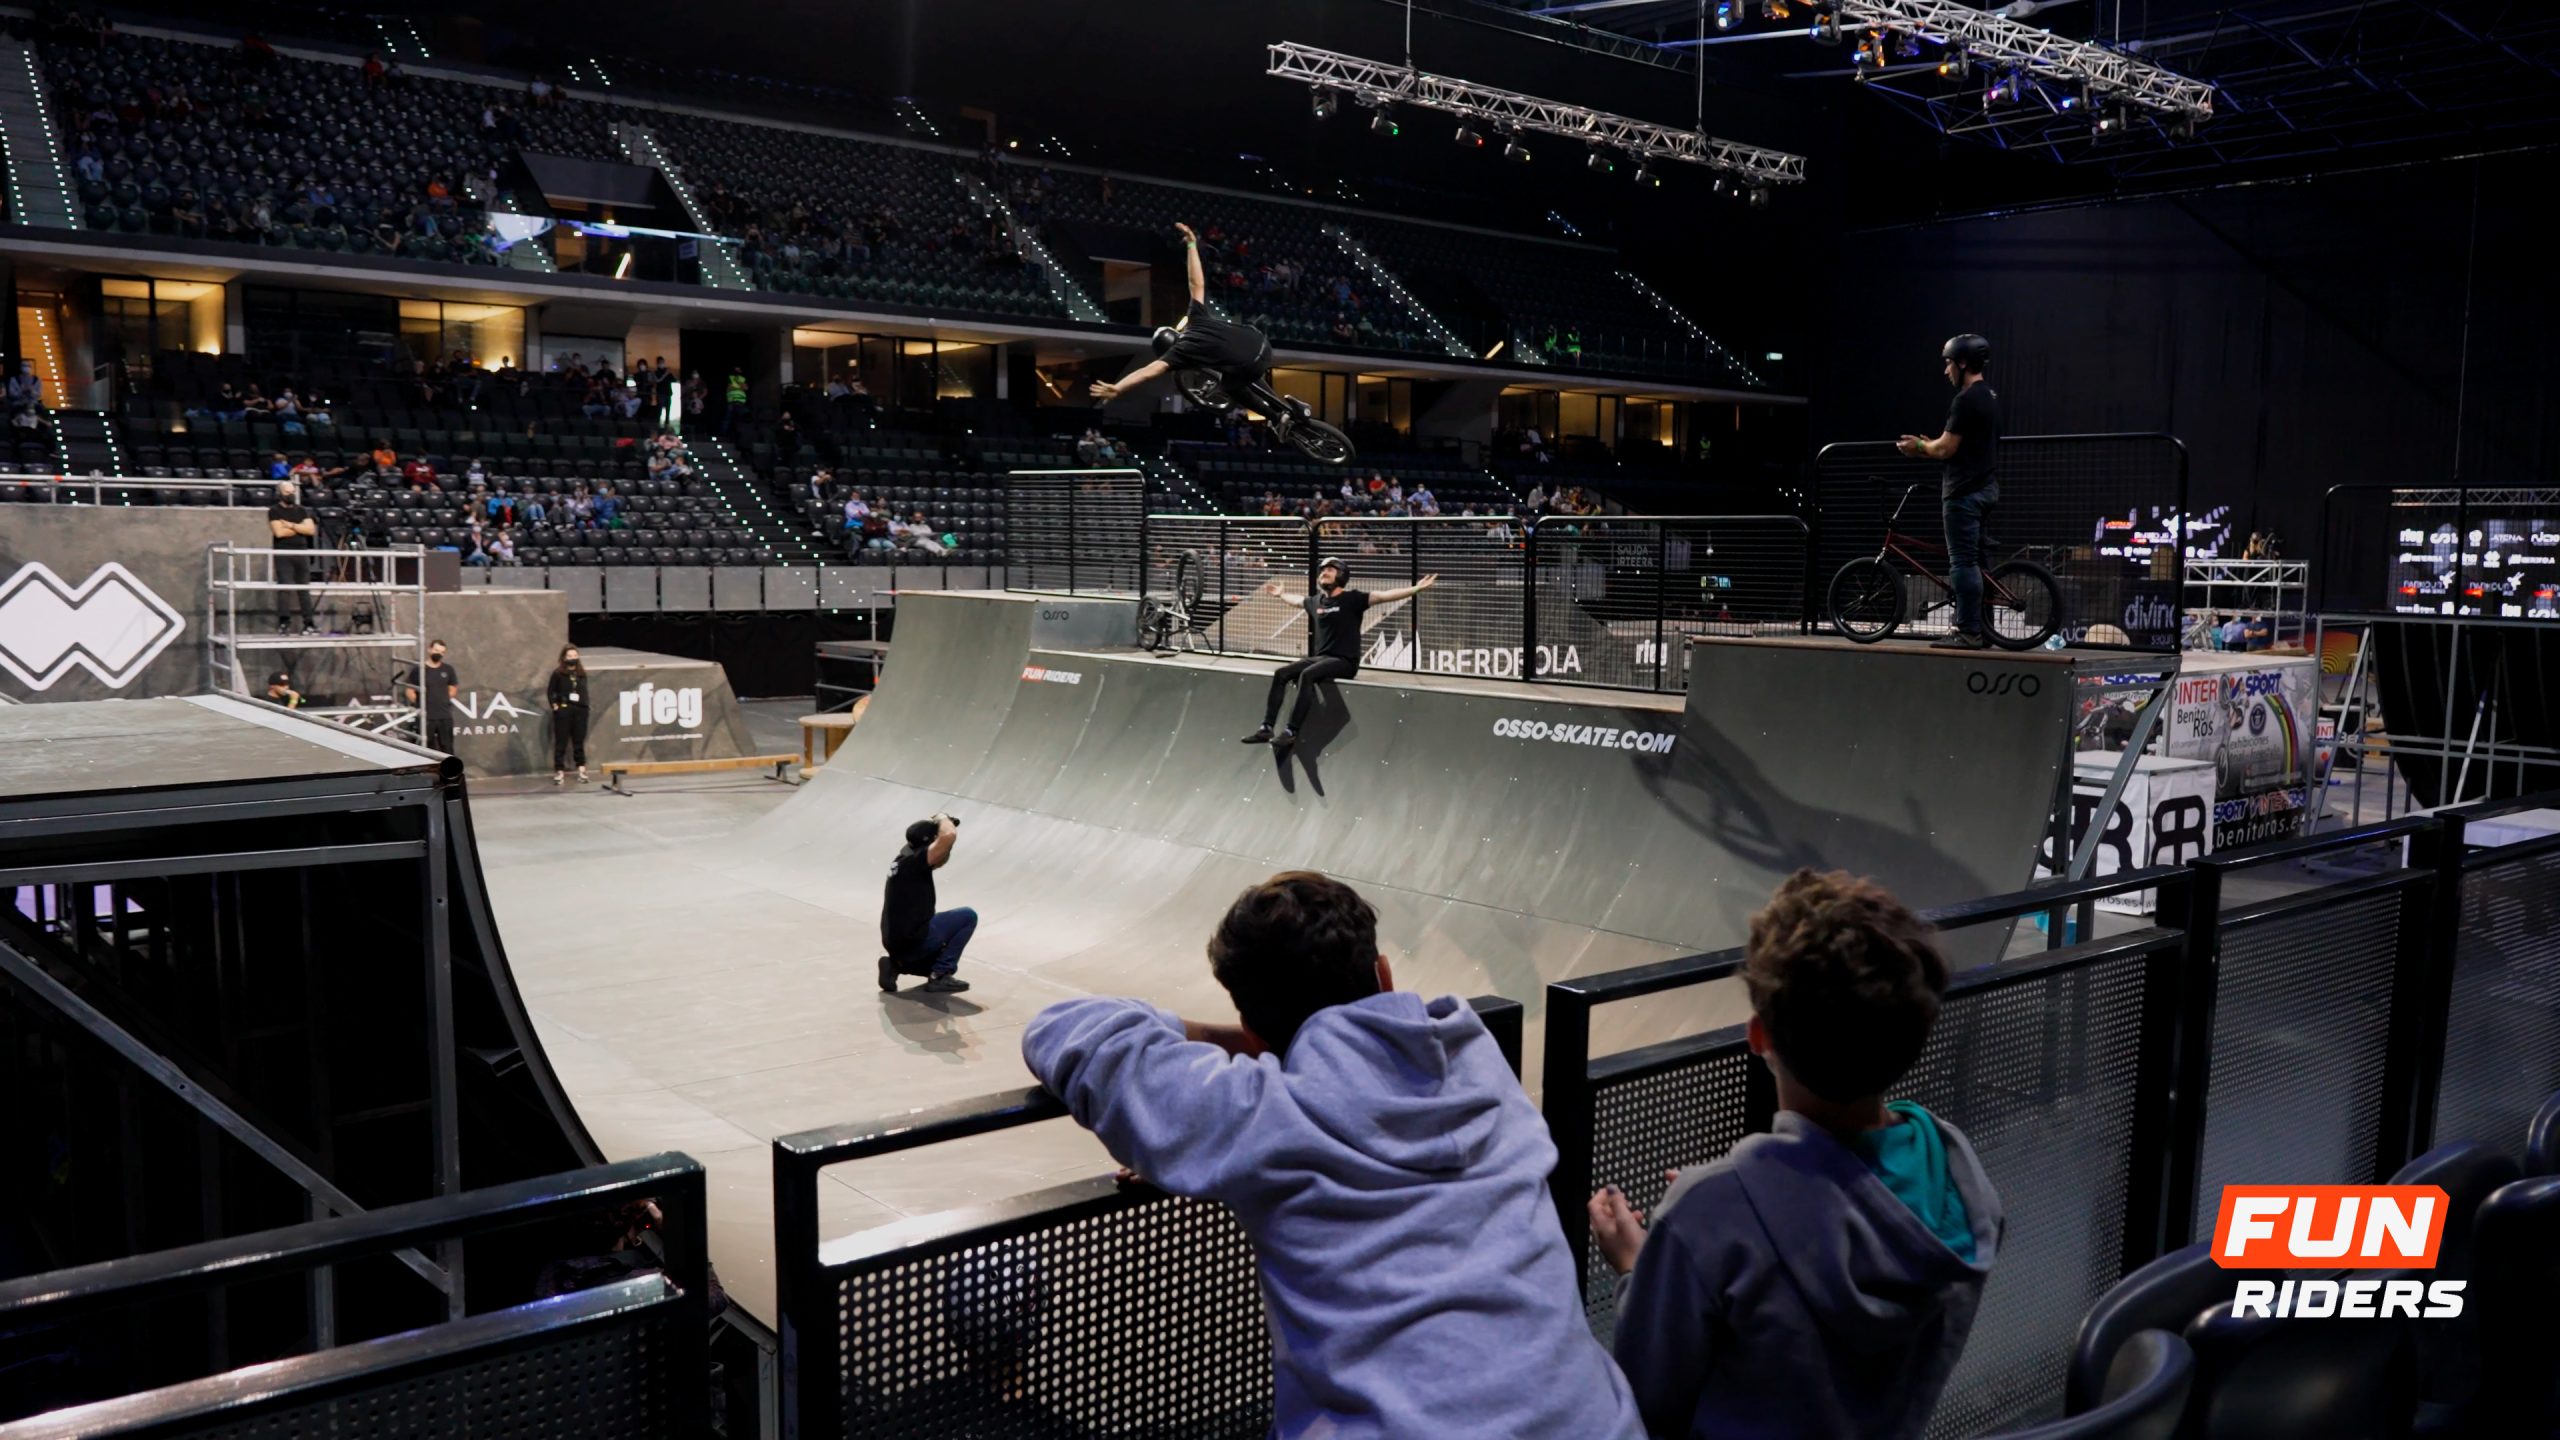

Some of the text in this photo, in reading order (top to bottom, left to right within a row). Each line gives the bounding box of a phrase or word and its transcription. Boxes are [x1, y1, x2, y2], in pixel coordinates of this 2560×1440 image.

[619, 682, 703, 728] rfeg
[2178, 678, 2219, 705] INTER
[2245, 673, 2282, 696] SPORT
[2177, 706, 2207, 725] Benito
[2192, 718, 2214, 738] Ros
[1493, 717, 1676, 755] OSSO-SKATE.COM
